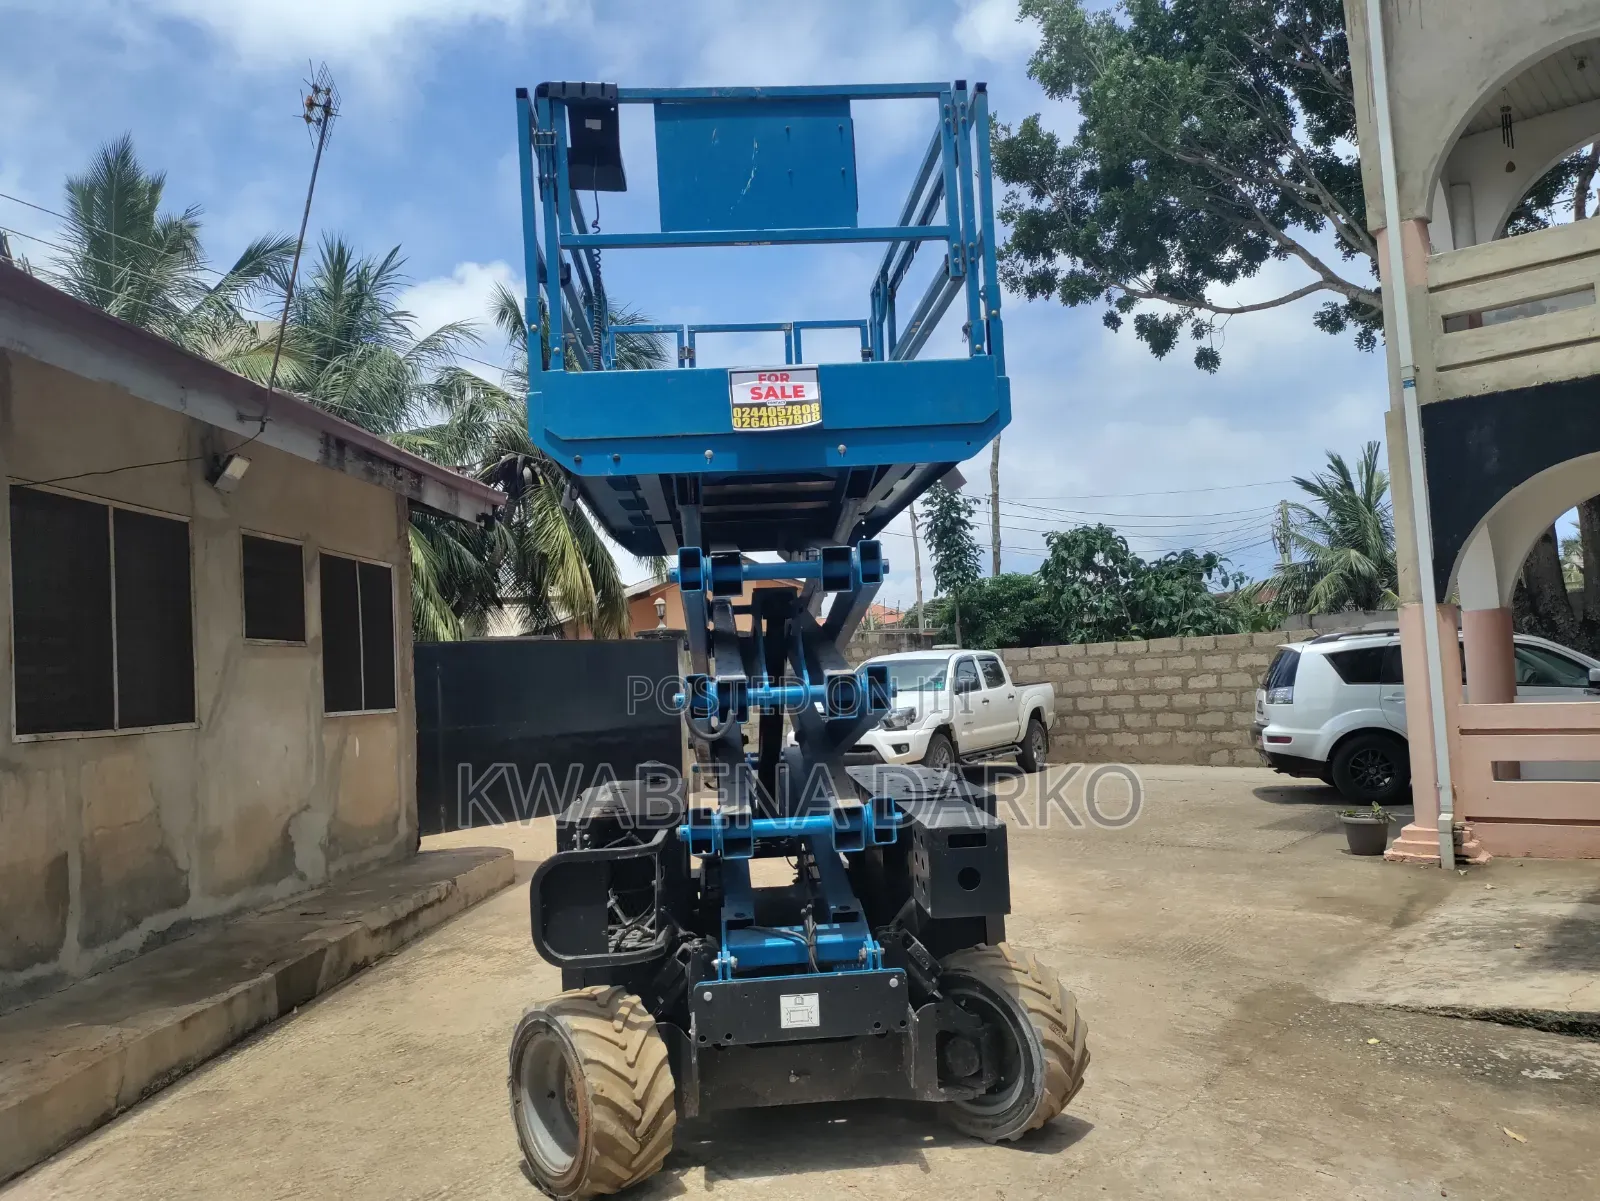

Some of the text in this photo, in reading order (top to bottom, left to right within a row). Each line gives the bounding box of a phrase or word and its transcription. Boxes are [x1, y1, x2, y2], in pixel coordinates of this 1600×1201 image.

[758, 373, 790, 383] FOR
[750, 385, 805, 400] SALE
[733, 403, 820, 418] 0244057808
[733, 412, 820, 428] 0264057808
